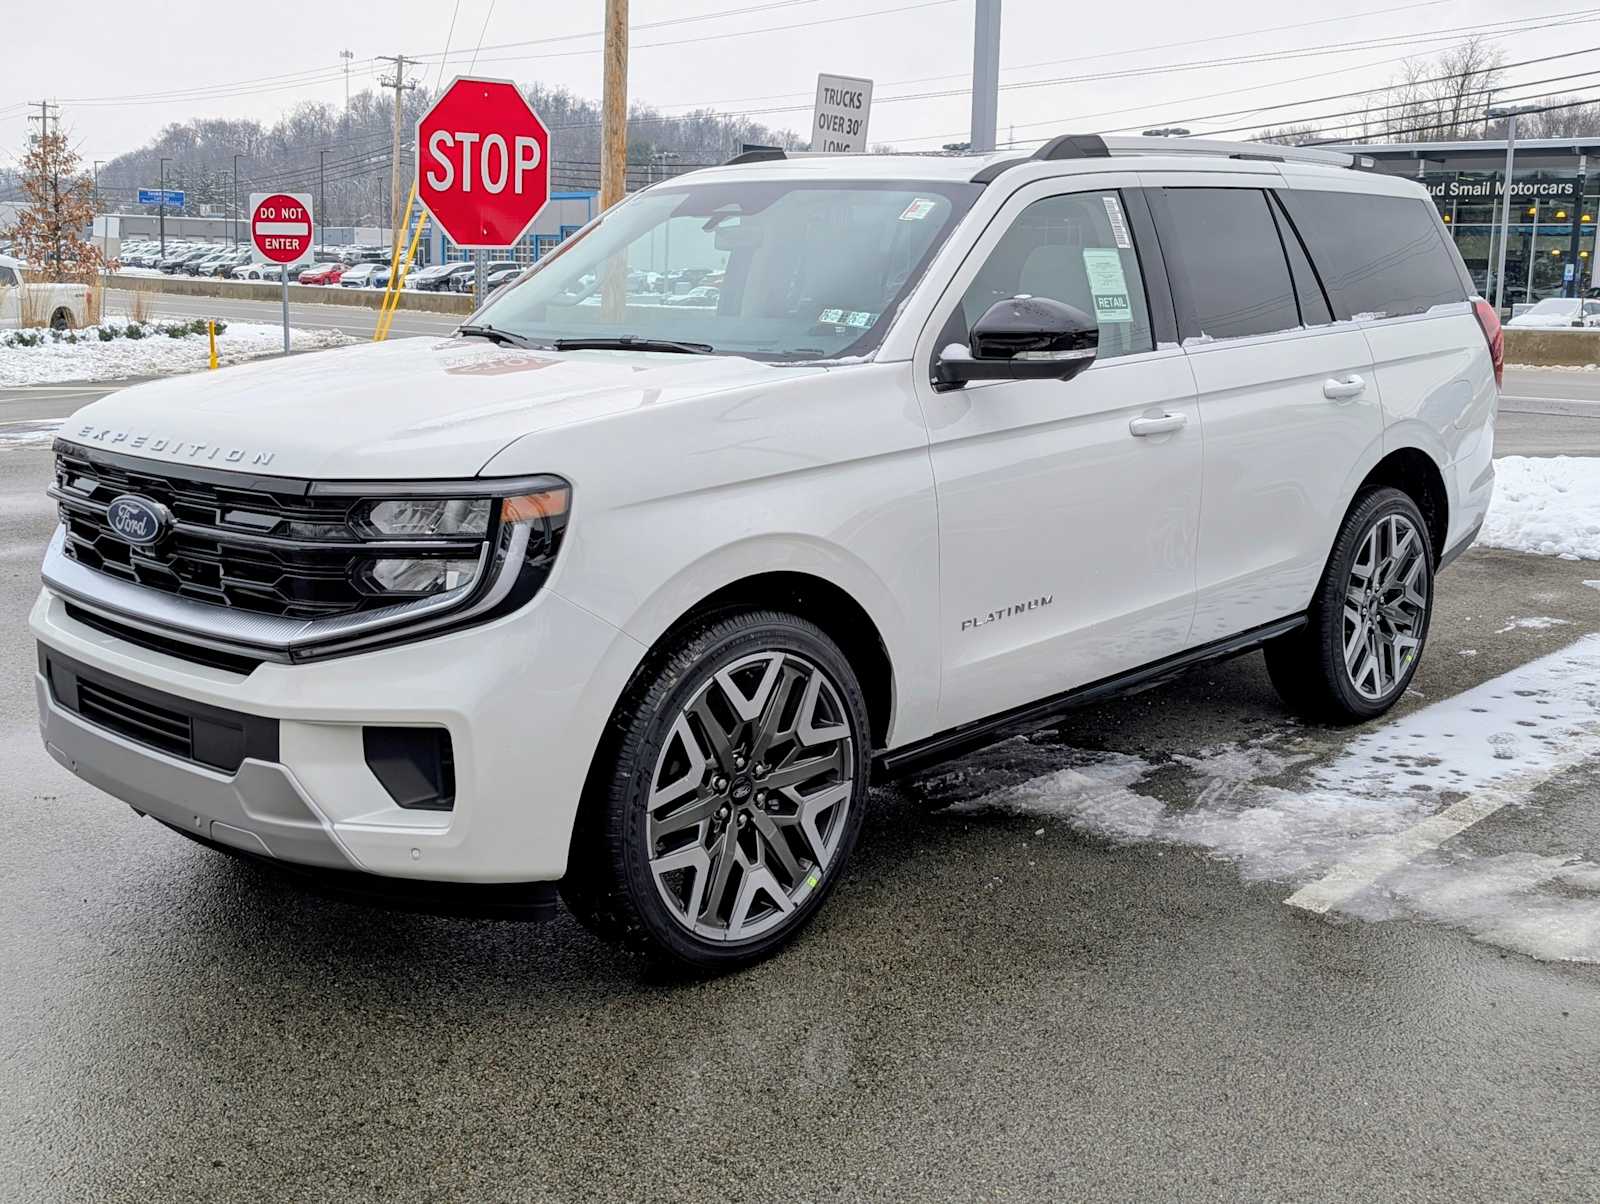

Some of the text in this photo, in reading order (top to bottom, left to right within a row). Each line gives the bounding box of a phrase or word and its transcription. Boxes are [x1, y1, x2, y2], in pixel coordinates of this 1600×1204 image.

[824, 87, 863, 110] TRUCKS
[818, 112, 846, 134] OVER
[426, 129, 542, 195] STOP
[1424, 182, 1574, 197] ud Smail Motorcars
[260, 207, 304, 220] DO NOT
[264, 238, 300, 251] ENTER
[1097, 296, 1127, 310] RETAIL
[78, 426, 276, 466] EXPEDITION
[114, 503, 149, 537] Ford
[961, 594, 1054, 632] PLATINUM
